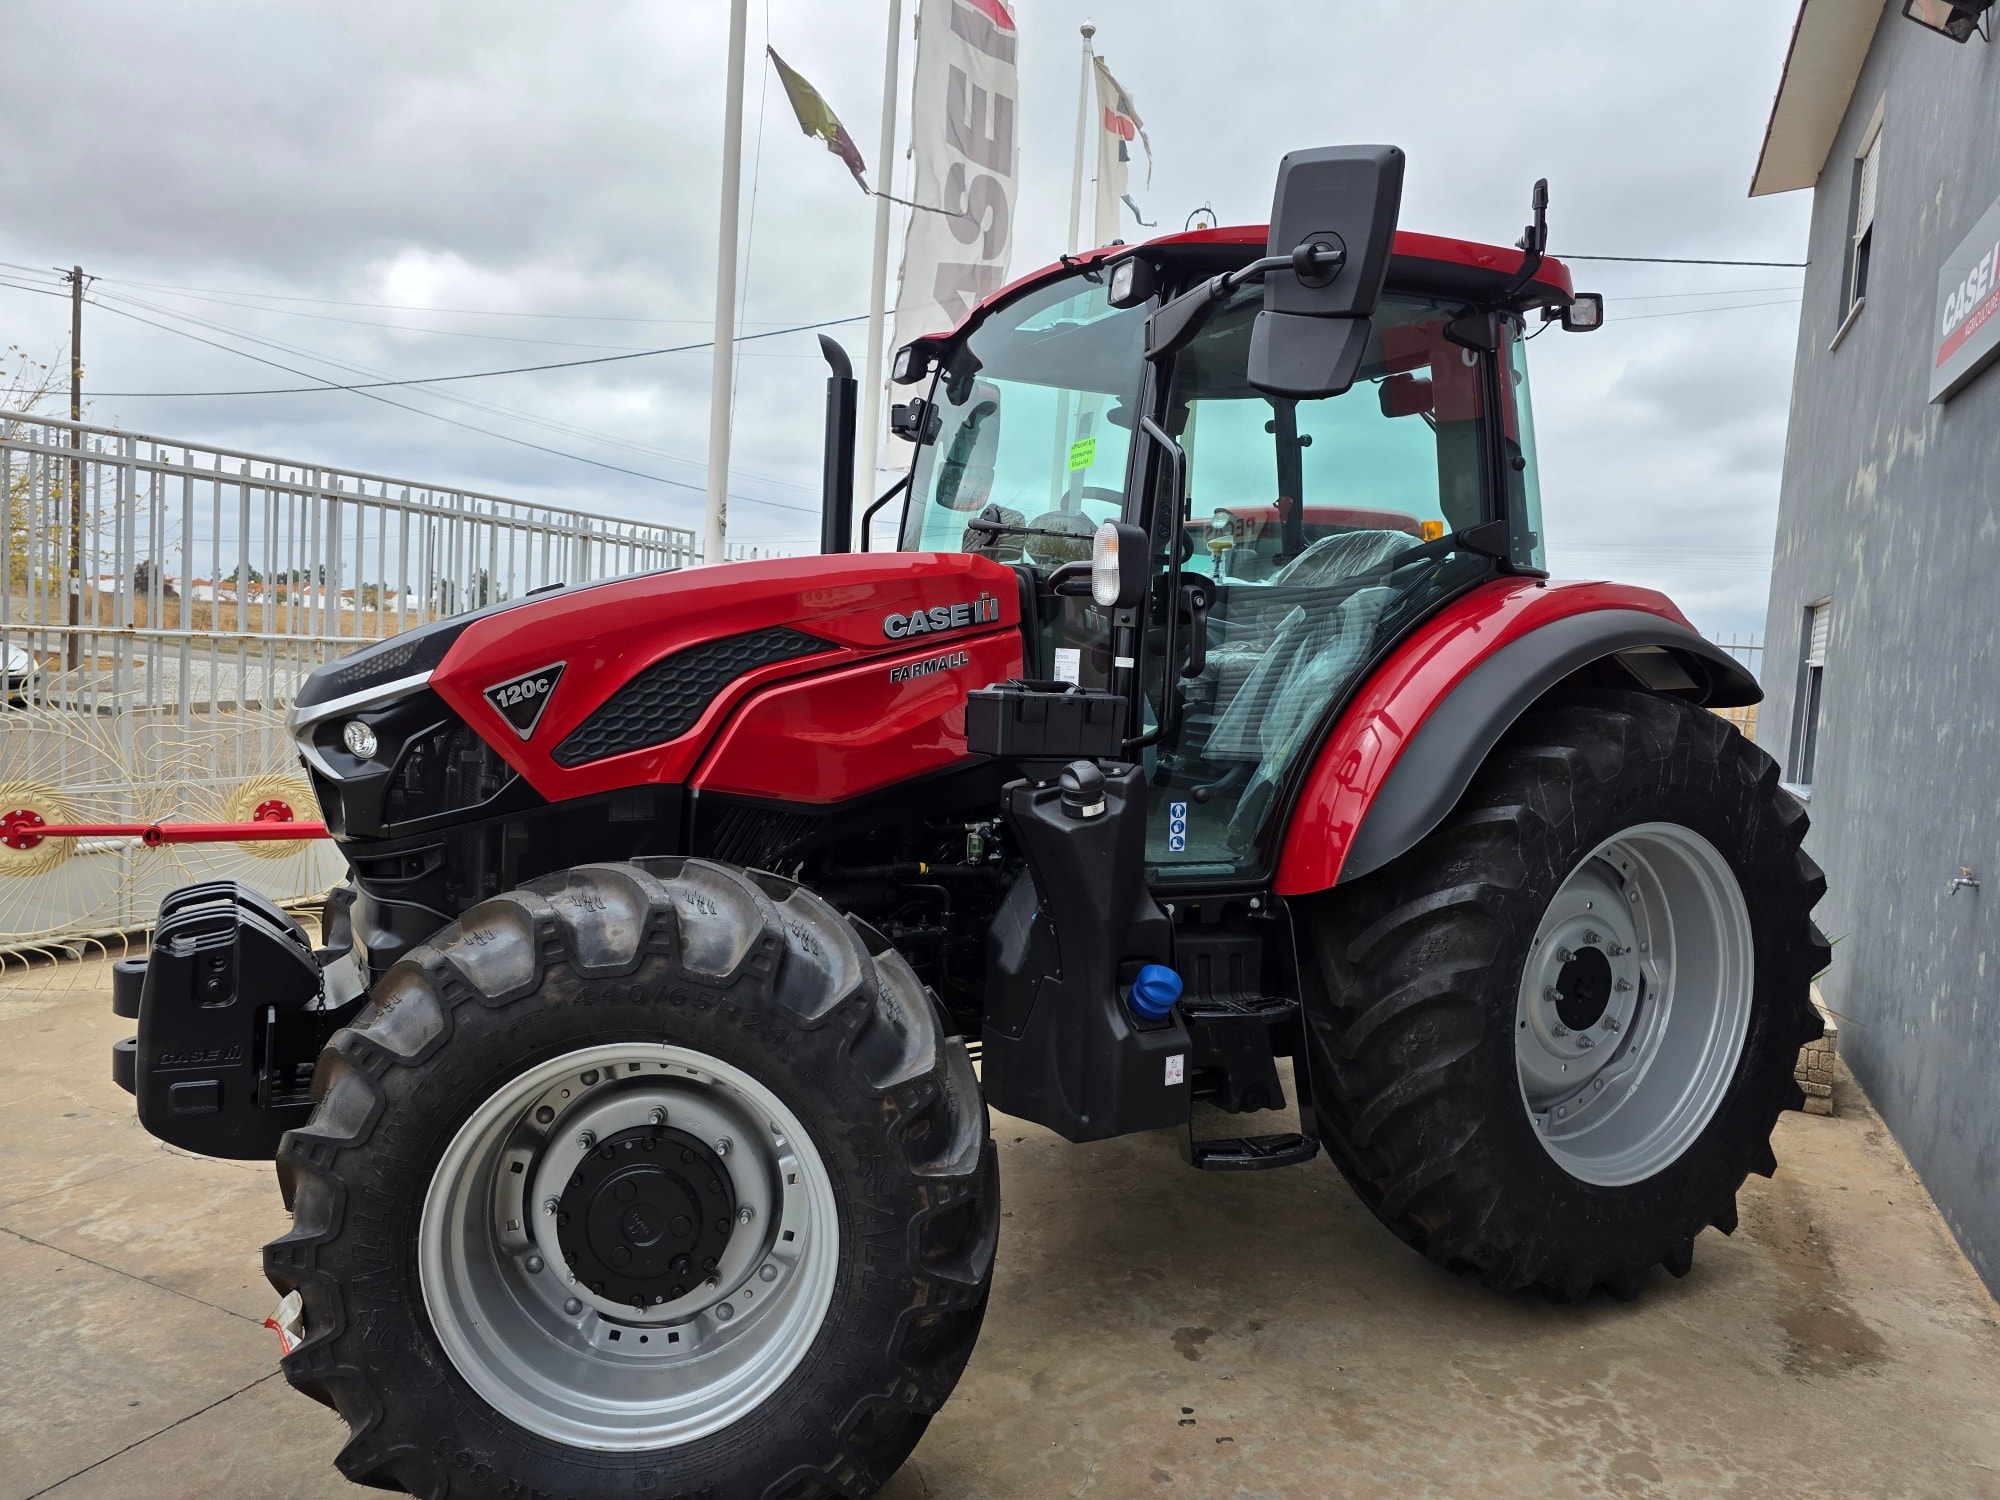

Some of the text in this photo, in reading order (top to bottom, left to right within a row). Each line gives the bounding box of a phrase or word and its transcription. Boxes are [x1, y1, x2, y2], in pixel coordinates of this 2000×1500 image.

[933, 63, 1014, 328] ASE
[1942, 249, 1992, 336] CASE
[1963, 291, 1999, 340] AGRICULTURE
[883, 602, 970, 639] CASE
[890, 651, 969, 683] FARMALL
[159, 1049, 220, 1065] CASE
